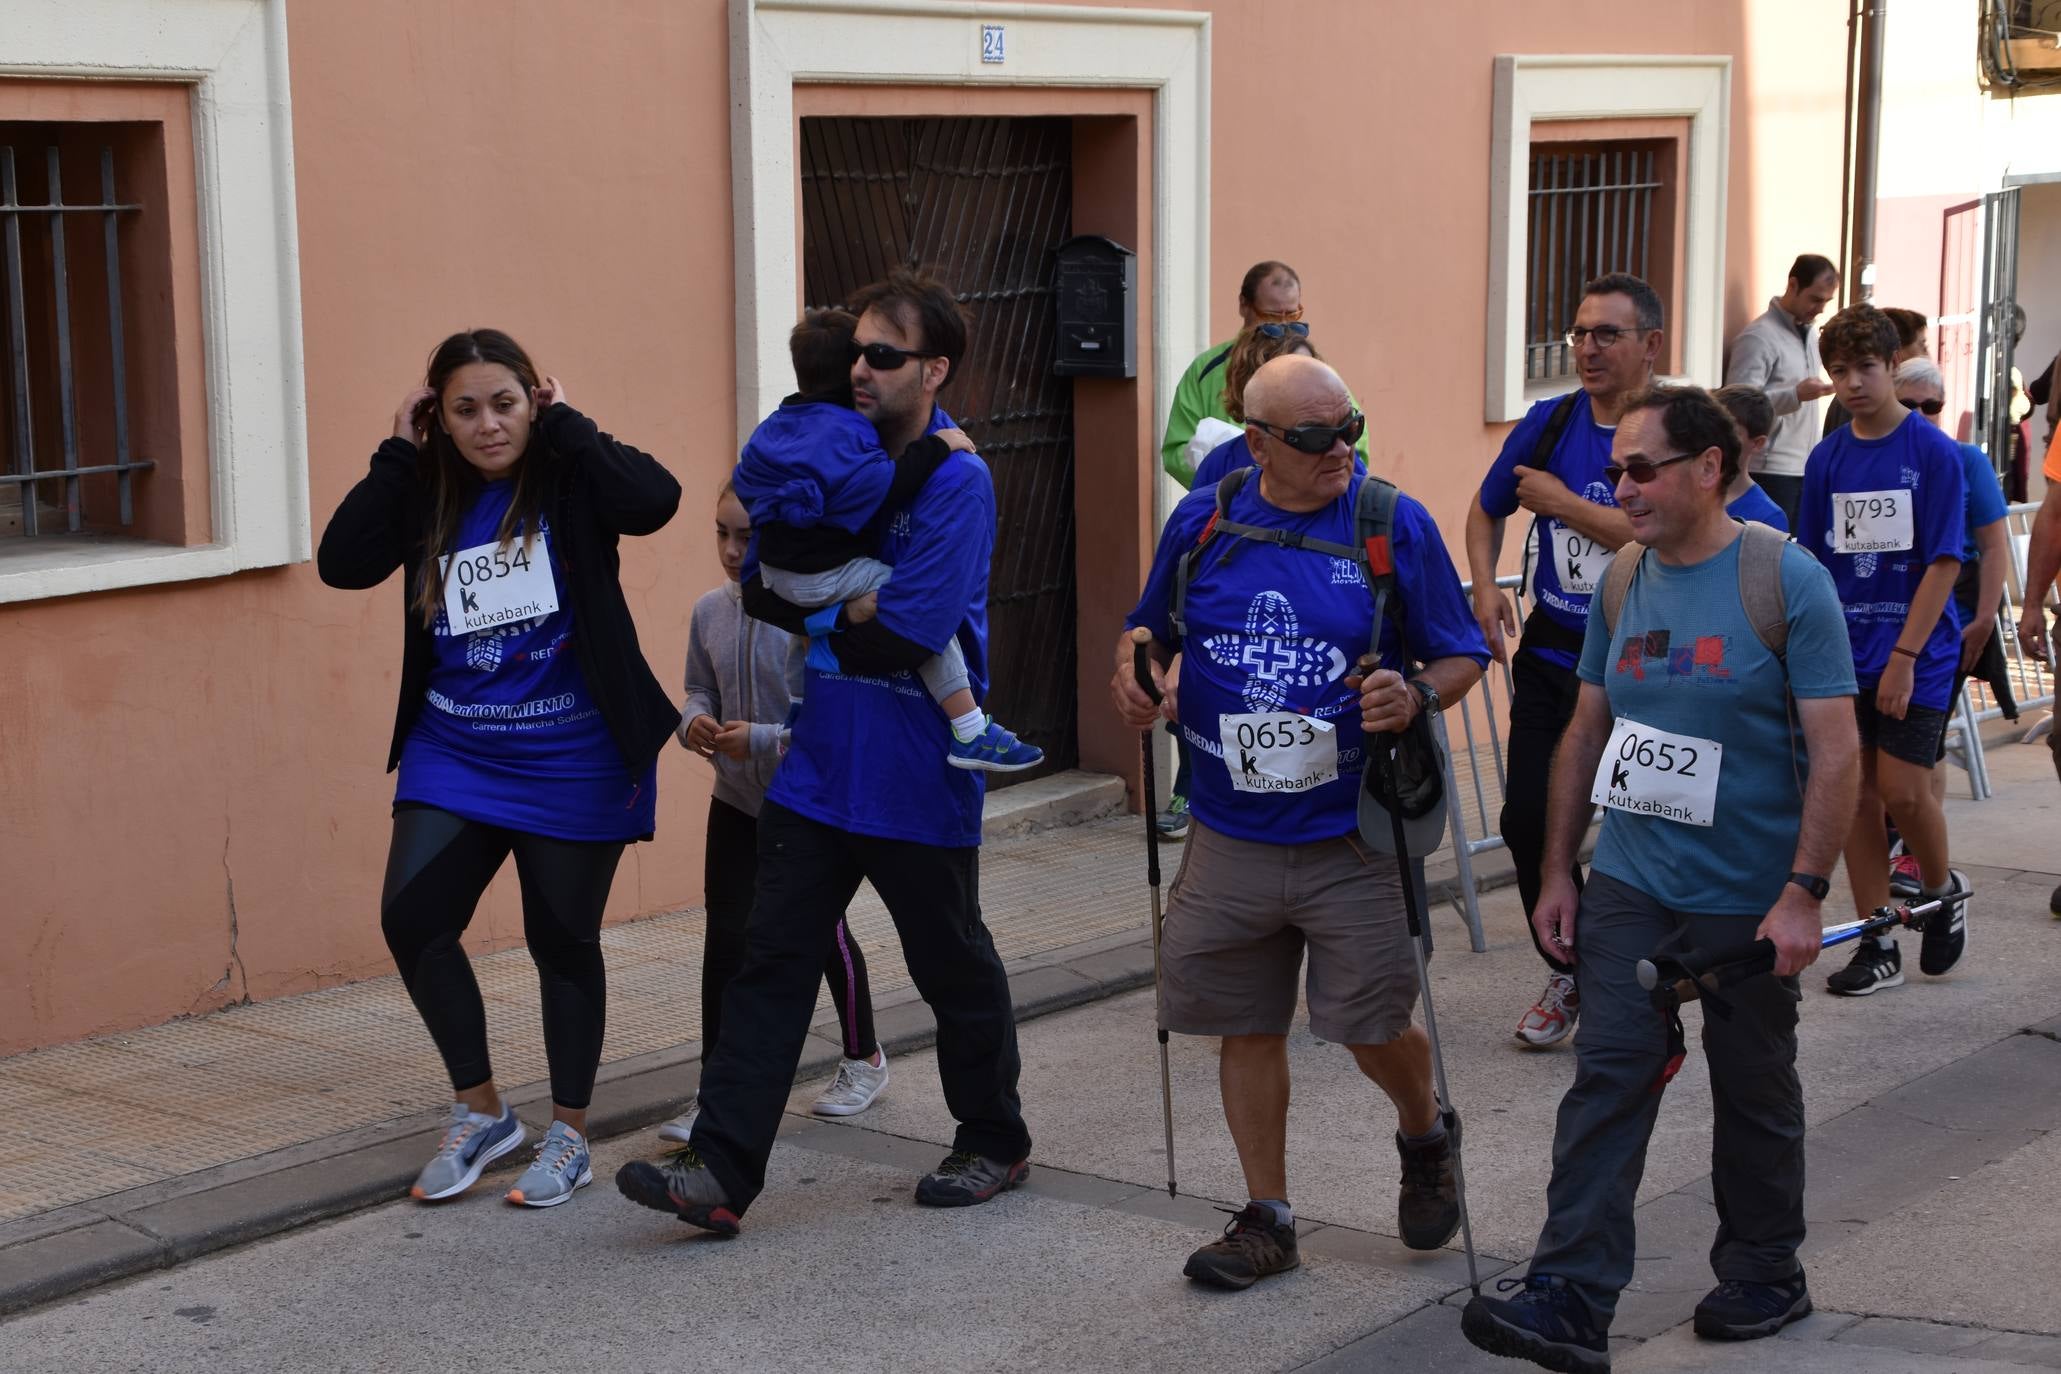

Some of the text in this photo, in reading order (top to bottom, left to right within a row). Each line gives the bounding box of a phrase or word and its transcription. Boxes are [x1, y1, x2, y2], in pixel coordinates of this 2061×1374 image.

[984, 30, 1004, 55] 24
[1844, 498, 1897, 519] 0793
[1845, 539, 1901, 550] kutxabank
[457, 546, 531, 586] 0854
[464, 600, 542, 629] kutxabank
[472, 721, 506, 731] Carrera
[515, 720, 554, 731] Marcha
[1237, 719, 1315, 749] 0653
[1620, 733, 1698, 777] 0652
[1244, 770, 1321, 790] kutxabank
[1607, 790, 1694, 822] kutxabank
